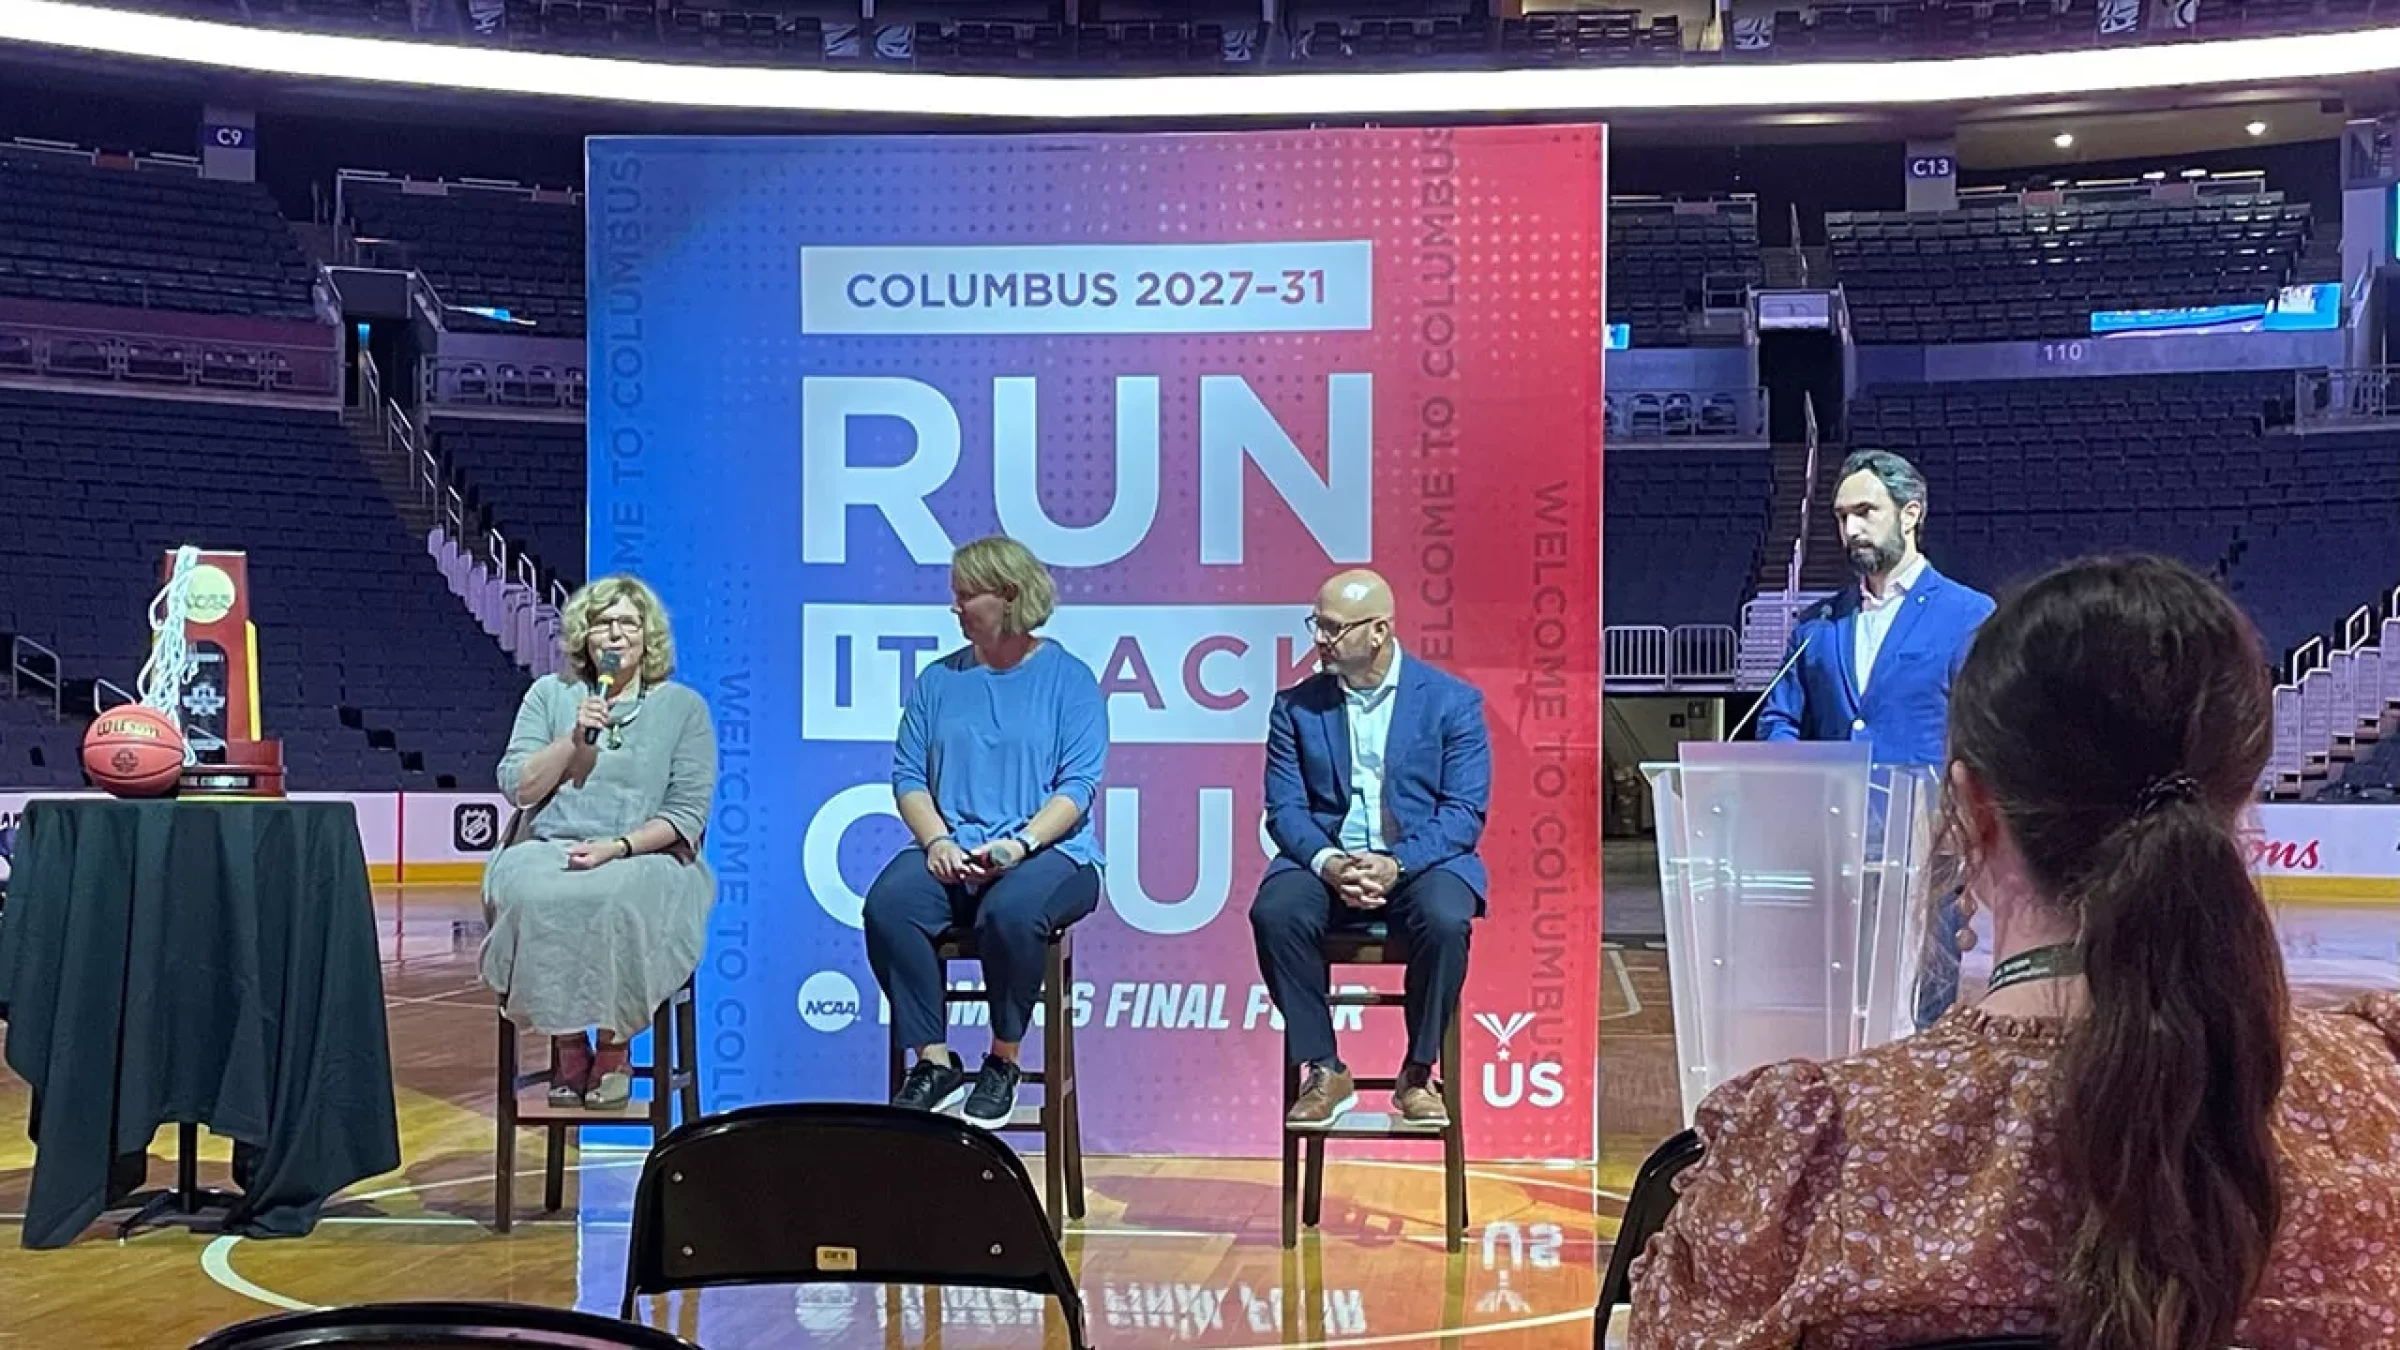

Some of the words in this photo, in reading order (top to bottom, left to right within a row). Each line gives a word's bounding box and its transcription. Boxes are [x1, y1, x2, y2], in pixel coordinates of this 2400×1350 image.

[217, 128, 242, 145] C9
[1913, 159, 1949, 175] C13
[608, 156, 644, 408] COLUMBUS
[846, 273, 1118, 308] COLUMBUS
[2043, 342, 2083, 361] 110
[611, 426, 644, 487] TO
[1421, 396, 1455, 458] TO
[803, 372, 1373, 568] RUN
[1420, 472, 1454, 660] ELCOME
[1532, 479, 1568, 720] WELCOME
[835, 634, 939, 708] IT
[1099, 634, 1322, 711] ACK
[717, 670, 751, 905] WELCOME
[1532, 733, 1567, 798] TO
[715, 920, 749, 981] TO
[805, 1000, 859, 1016] NCAA
[1104, 982, 1230, 1029] FINAL
[1243, 983, 1369, 1030] FR
[1482, 1062, 1565, 1108] US
